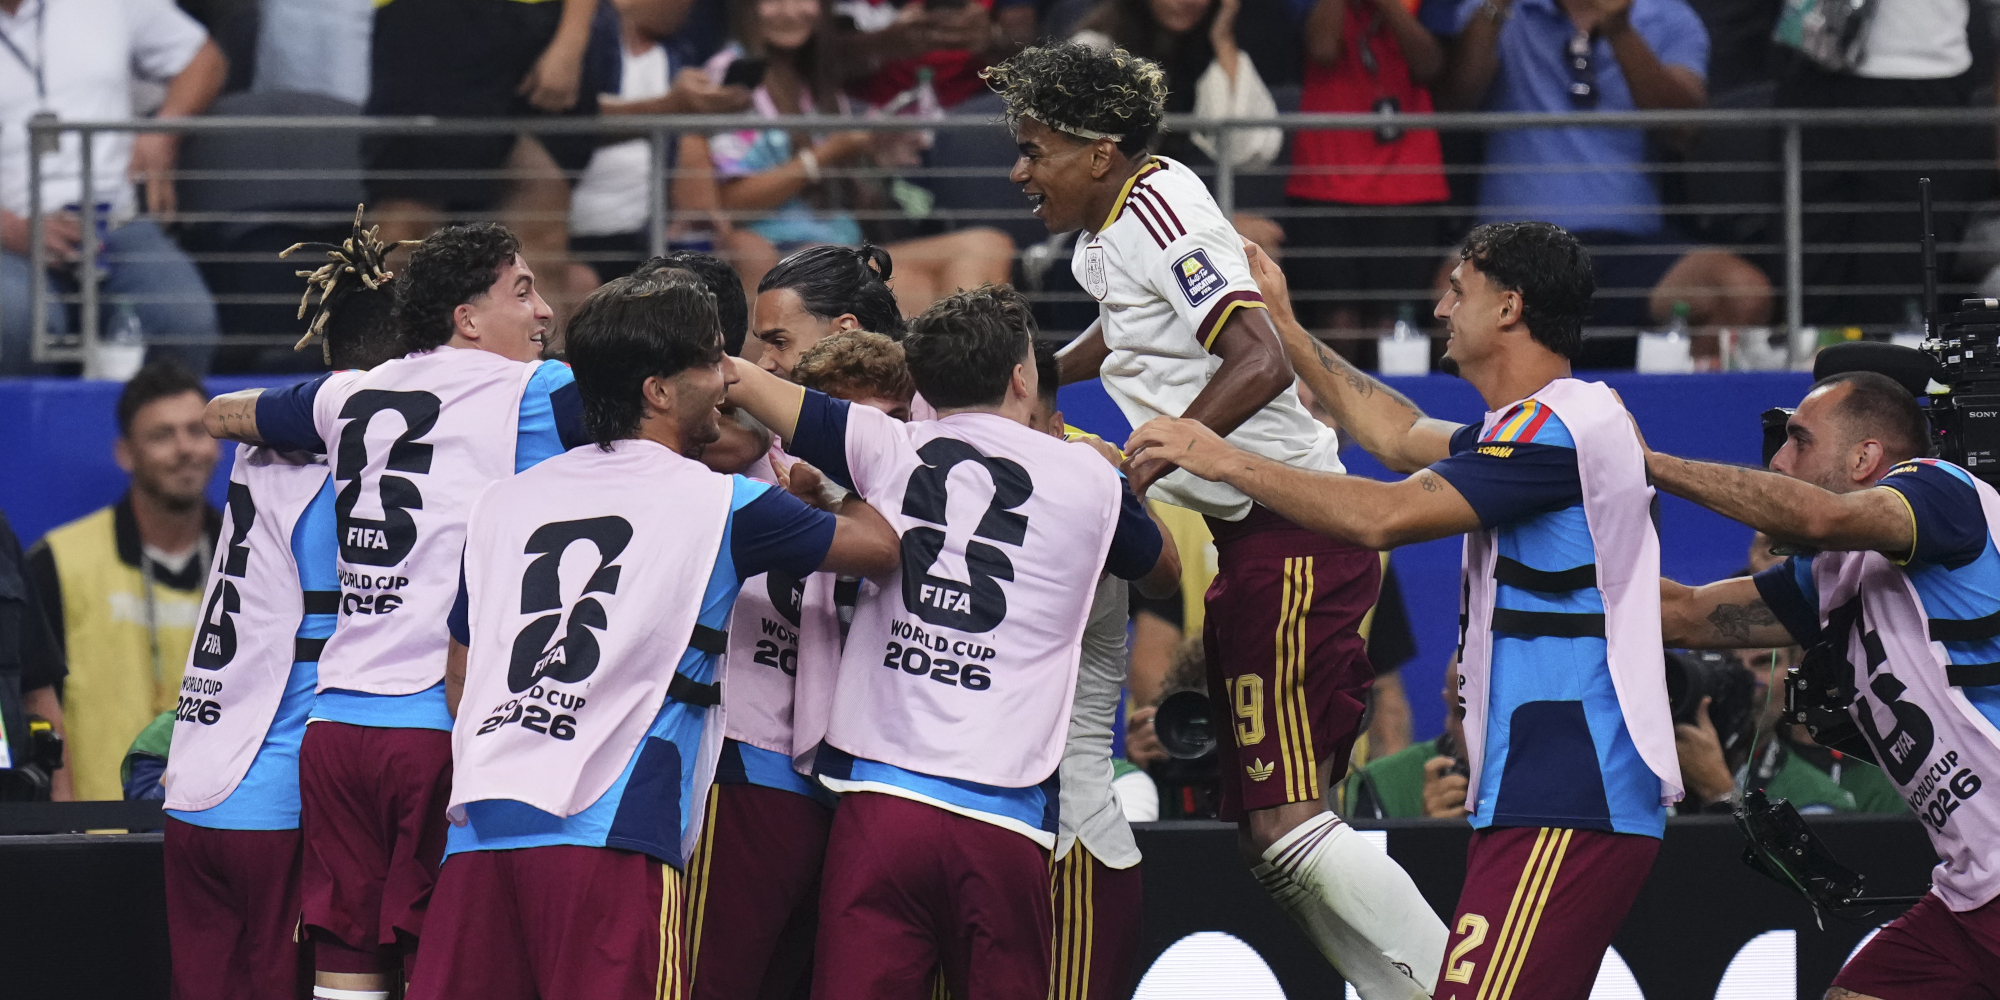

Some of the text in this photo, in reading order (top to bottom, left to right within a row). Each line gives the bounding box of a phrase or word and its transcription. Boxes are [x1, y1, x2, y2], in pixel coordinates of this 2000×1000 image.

[1189, 273, 1218, 297] EDUCATION
[347, 526, 388, 550] FIFA
[341, 593, 404, 616] 026
[920, 583, 971, 615] FIFA
[202, 632, 222, 656] FIFA
[762, 617, 799, 646] WOR
[891, 619, 996, 661] WORLD CUP
[753, 639, 798, 678] 20
[883, 641, 992, 691] 2026
[181, 674, 223, 696] WORLD CUP
[546, 690, 586, 711] CUP
[175, 695, 222, 726] 2026
[475, 704, 577, 741] 2026
[1889, 729, 1917, 765] FIFA
[1929, 750, 1959, 782] CUP
[1444, 912, 1490, 985] 2
